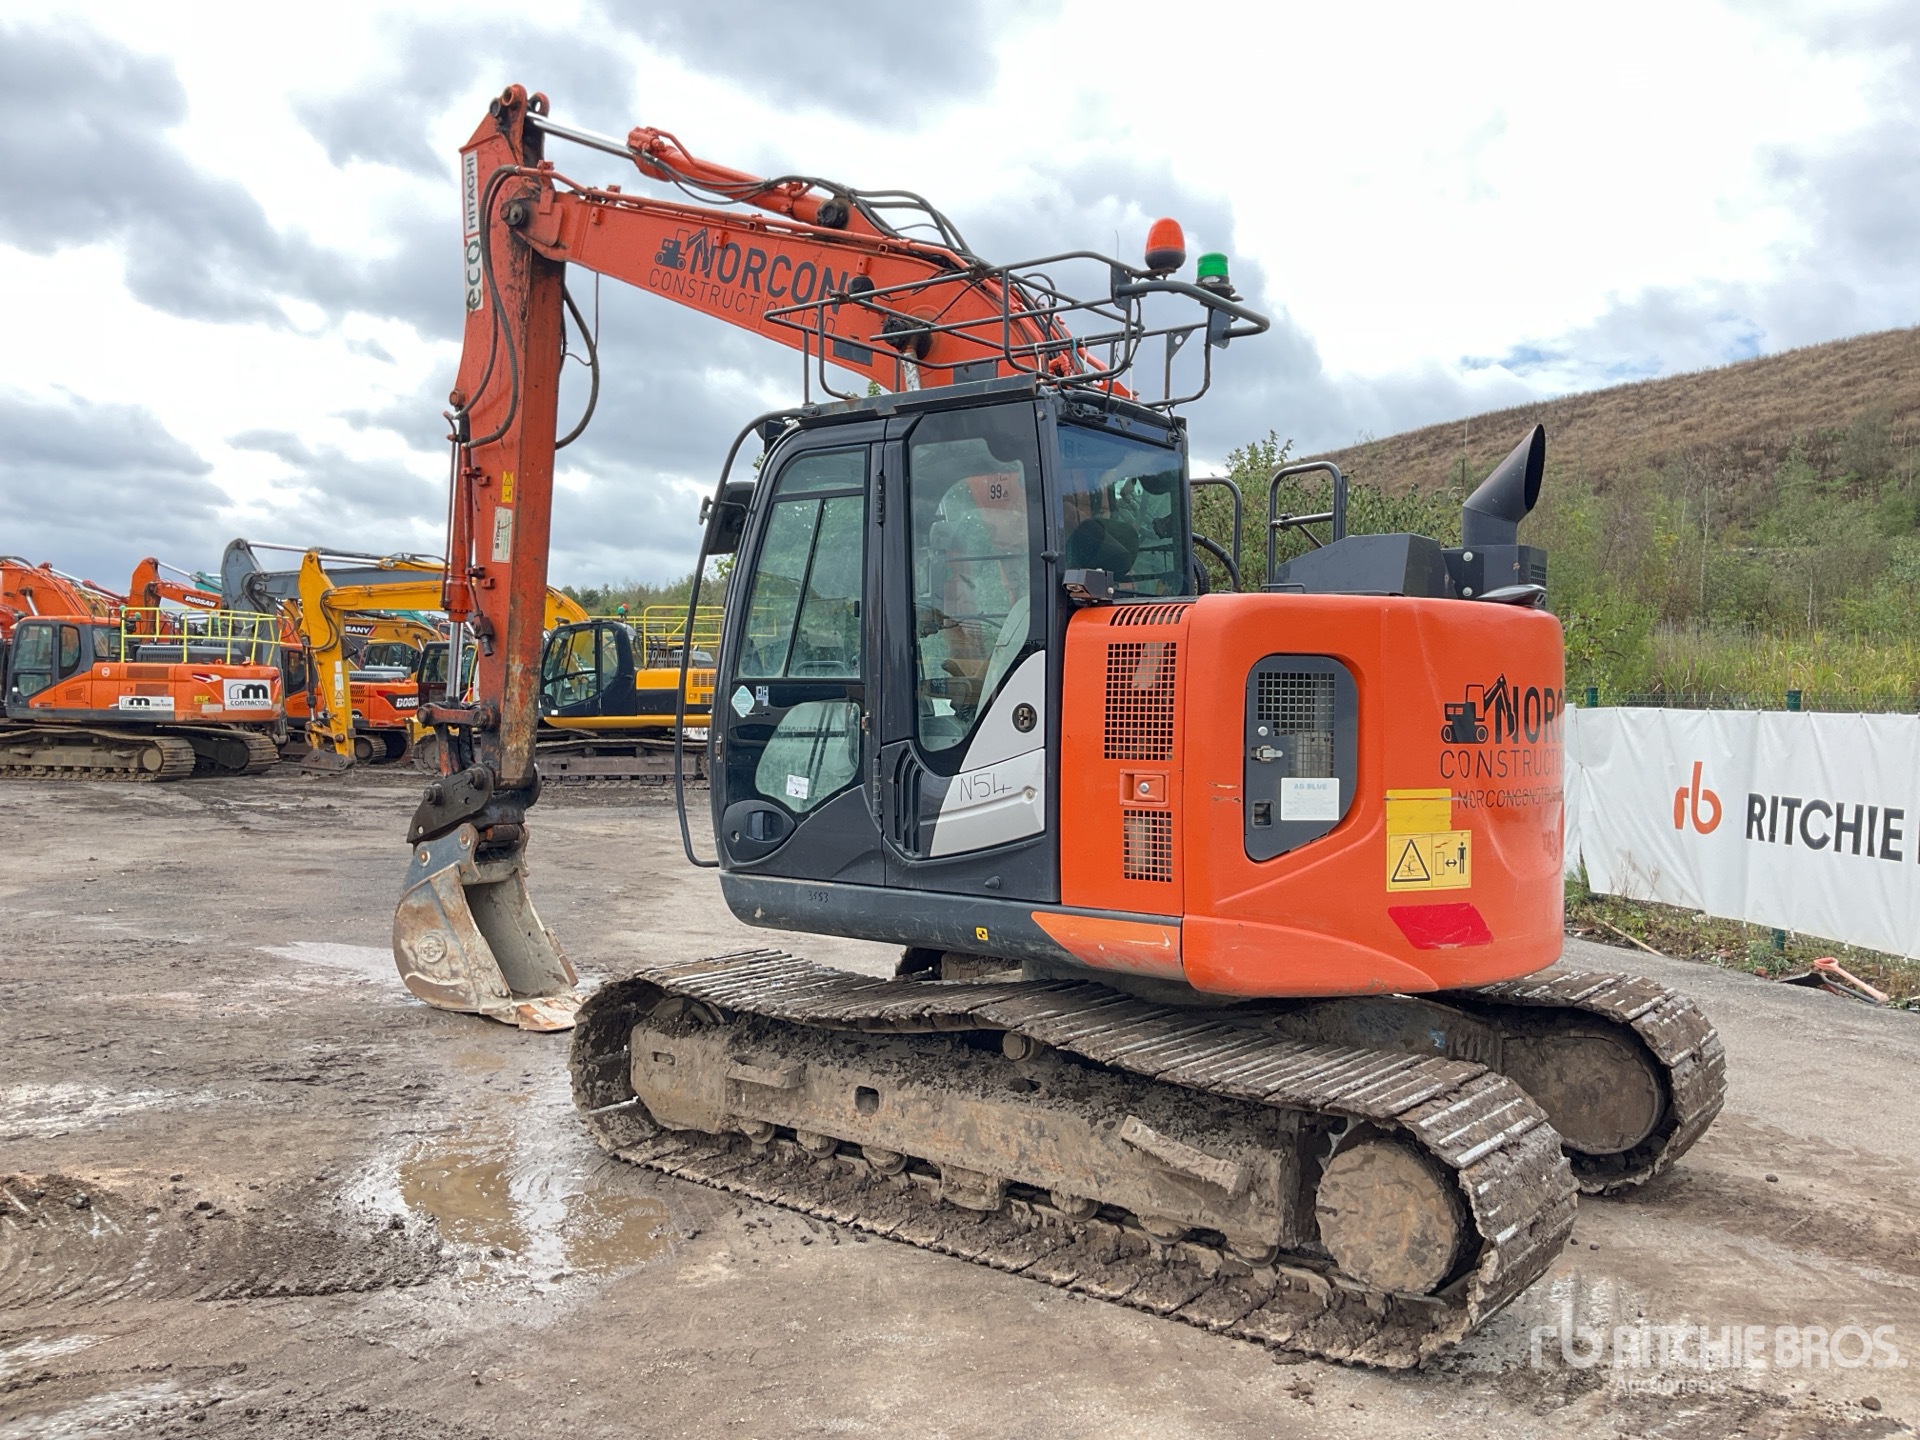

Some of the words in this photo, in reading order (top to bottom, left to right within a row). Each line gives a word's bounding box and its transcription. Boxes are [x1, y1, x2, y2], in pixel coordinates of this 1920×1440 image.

[466, 157, 475, 230] HITACHI
[689, 238, 848, 315] NORCON
[990, 484, 1002, 499] 99
[184, 595, 216, 607] DOOSAN
[345, 625, 370, 634] SANY
[960, 772, 1012, 802] N54
[1746, 793, 1905, 862] RITCHIE
